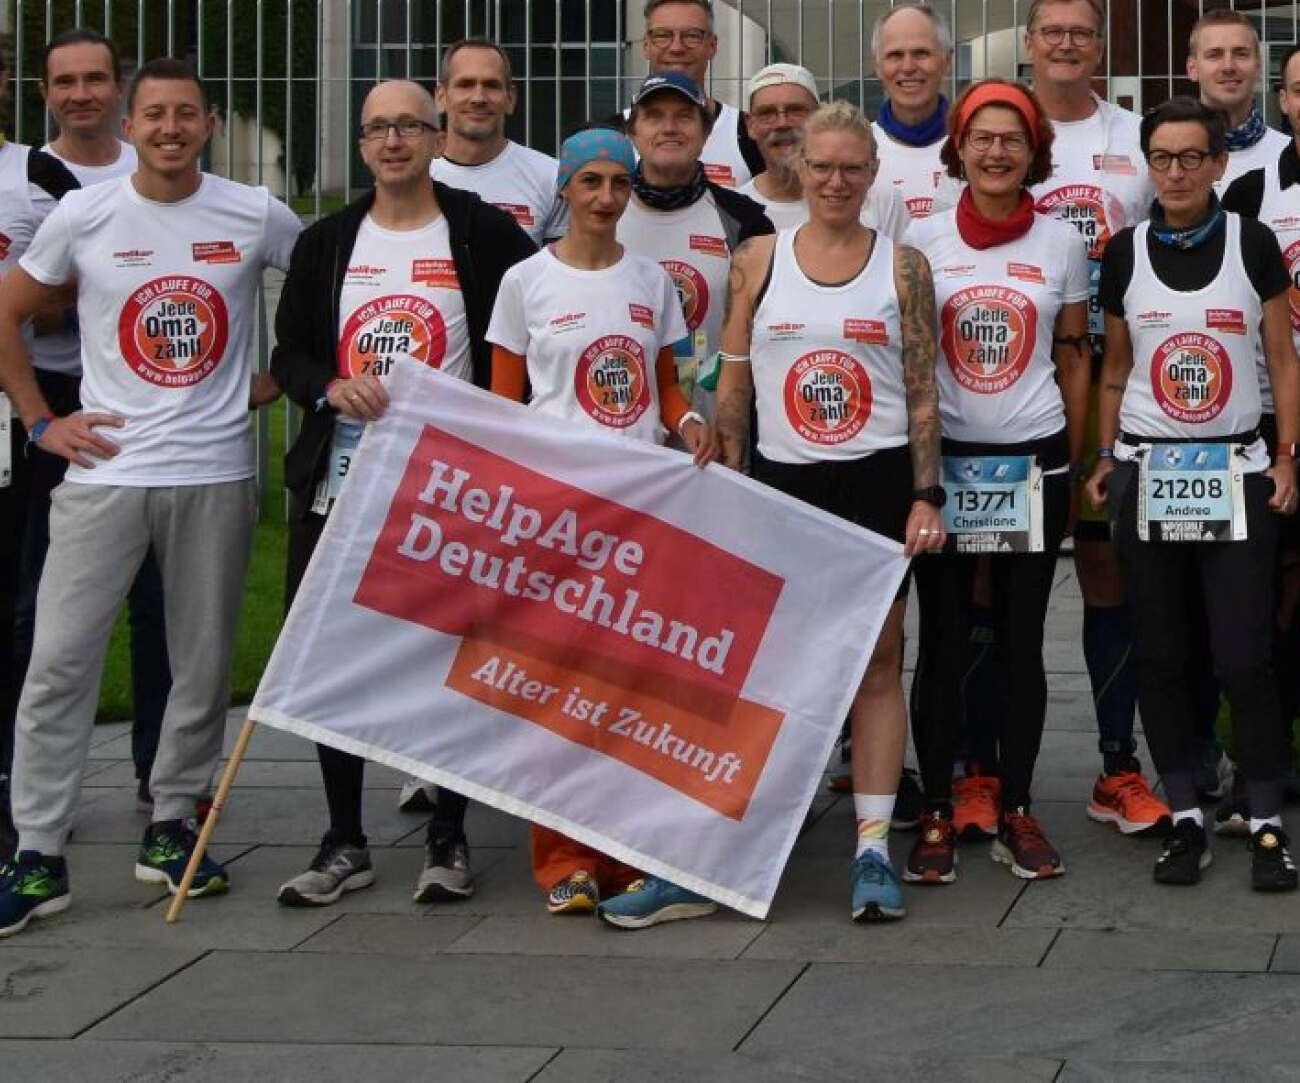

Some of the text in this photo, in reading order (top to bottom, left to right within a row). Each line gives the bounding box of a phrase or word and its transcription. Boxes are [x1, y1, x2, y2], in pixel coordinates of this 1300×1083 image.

[158, 301, 196, 317] Jede
[971, 306, 1009, 323] Jede
[146, 316, 197, 338] Oma
[374, 319, 414, 334] Jede
[961, 320, 1007, 342] Oma
[154, 338, 202, 360] zählt
[358, 333, 410, 354] Oma
[967, 344, 1009, 365] zählt
[1177, 353, 1206, 365] Jede
[594, 369, 629, 387] Oma
[811, 371, 843, 385] Jede
[1169, 363, 1206, 382] Oma
[802, 384, 843, 403] Oma
[1174, 383, 1209, 400] zählt
[810, 403, 849, 421] zählt
[1152, 478, 1223, 499] 21208
[954, 490, 1015, 512] 13771
[1165, 505, 1211, 516] Andrea
[418, 460, 645, 577] HelpAge
[953, 516, 1017, 528] Christiane
[398, 513, 735, 676] Deutschland
[471, 655, 742, 785] Alter ist Zukunft
